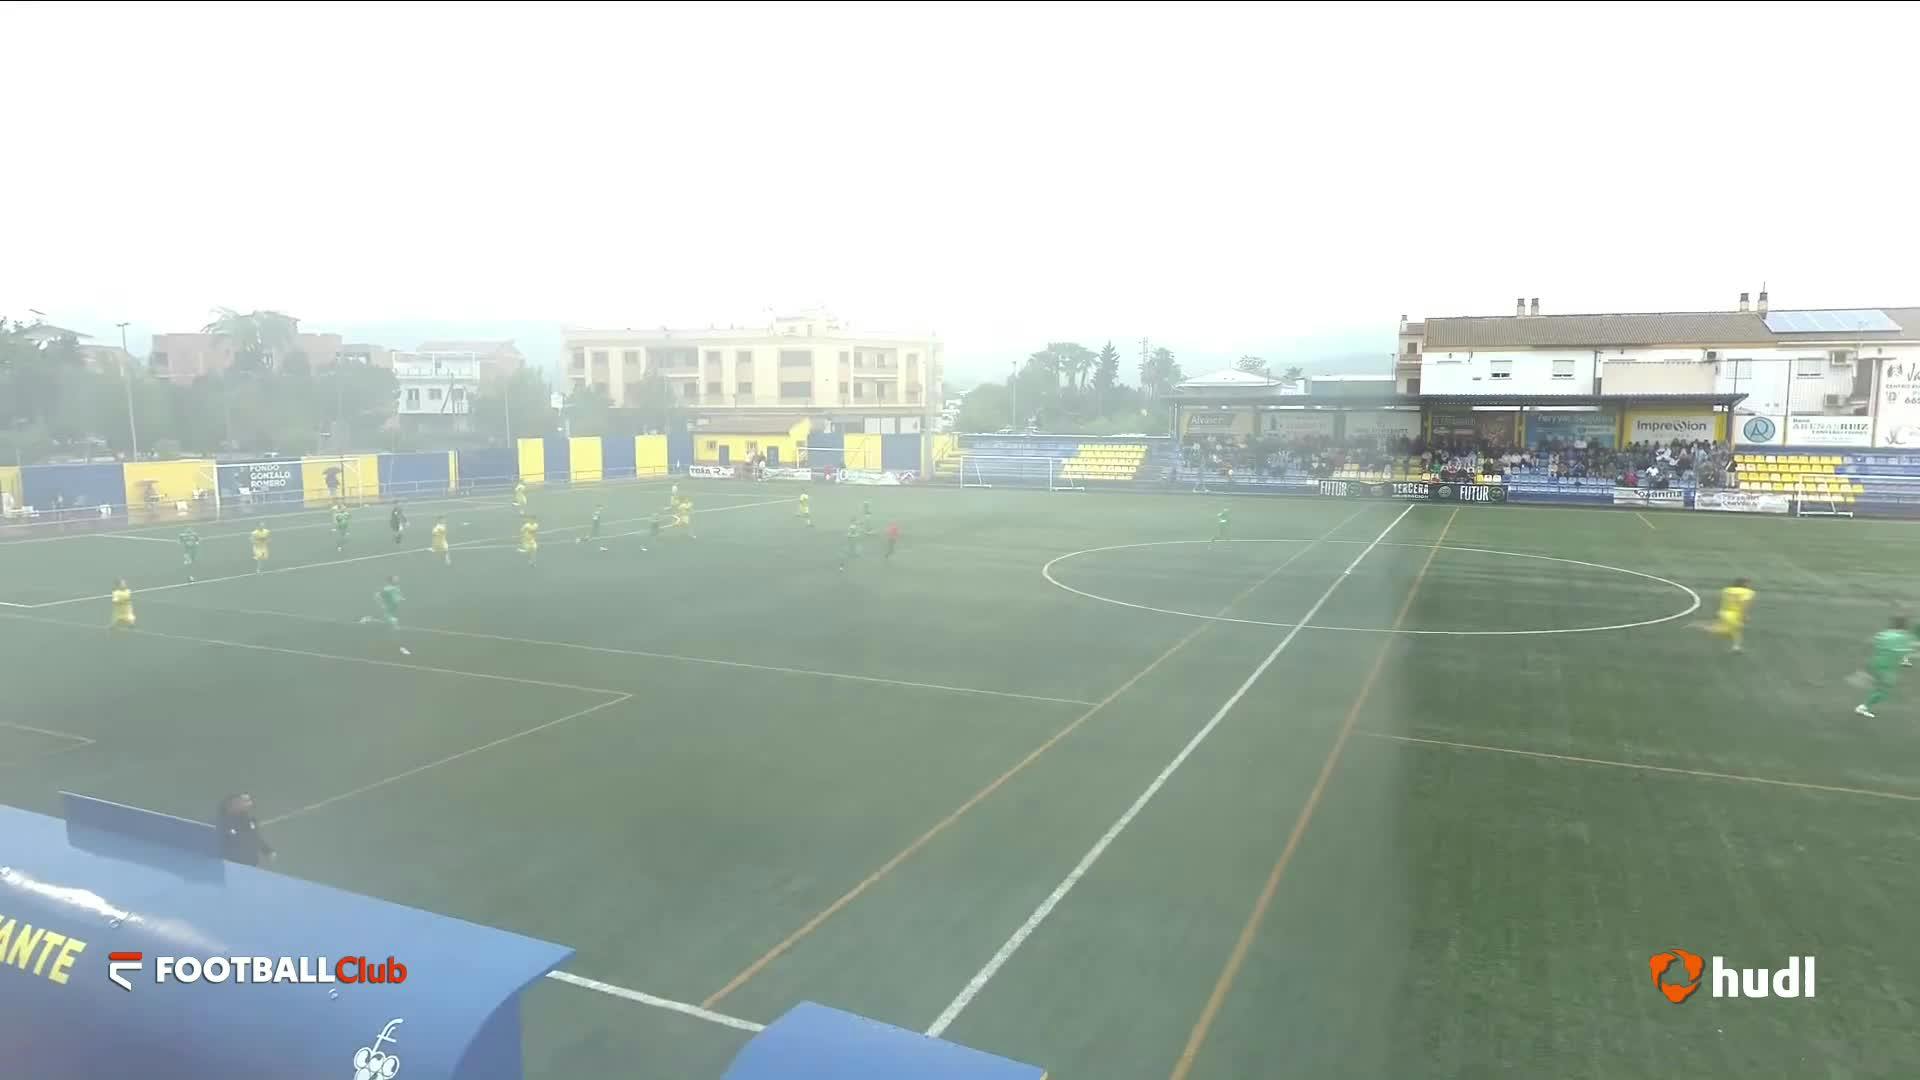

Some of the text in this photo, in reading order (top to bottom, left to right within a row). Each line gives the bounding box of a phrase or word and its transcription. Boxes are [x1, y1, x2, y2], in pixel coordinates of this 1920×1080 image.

[250, 464, 279, 472] FONDO
[250, 472, 290, 480] GONZALO
[251, 480, 286, 488] ROMERO
[1392, 483, 1429, 494] TERCERA
